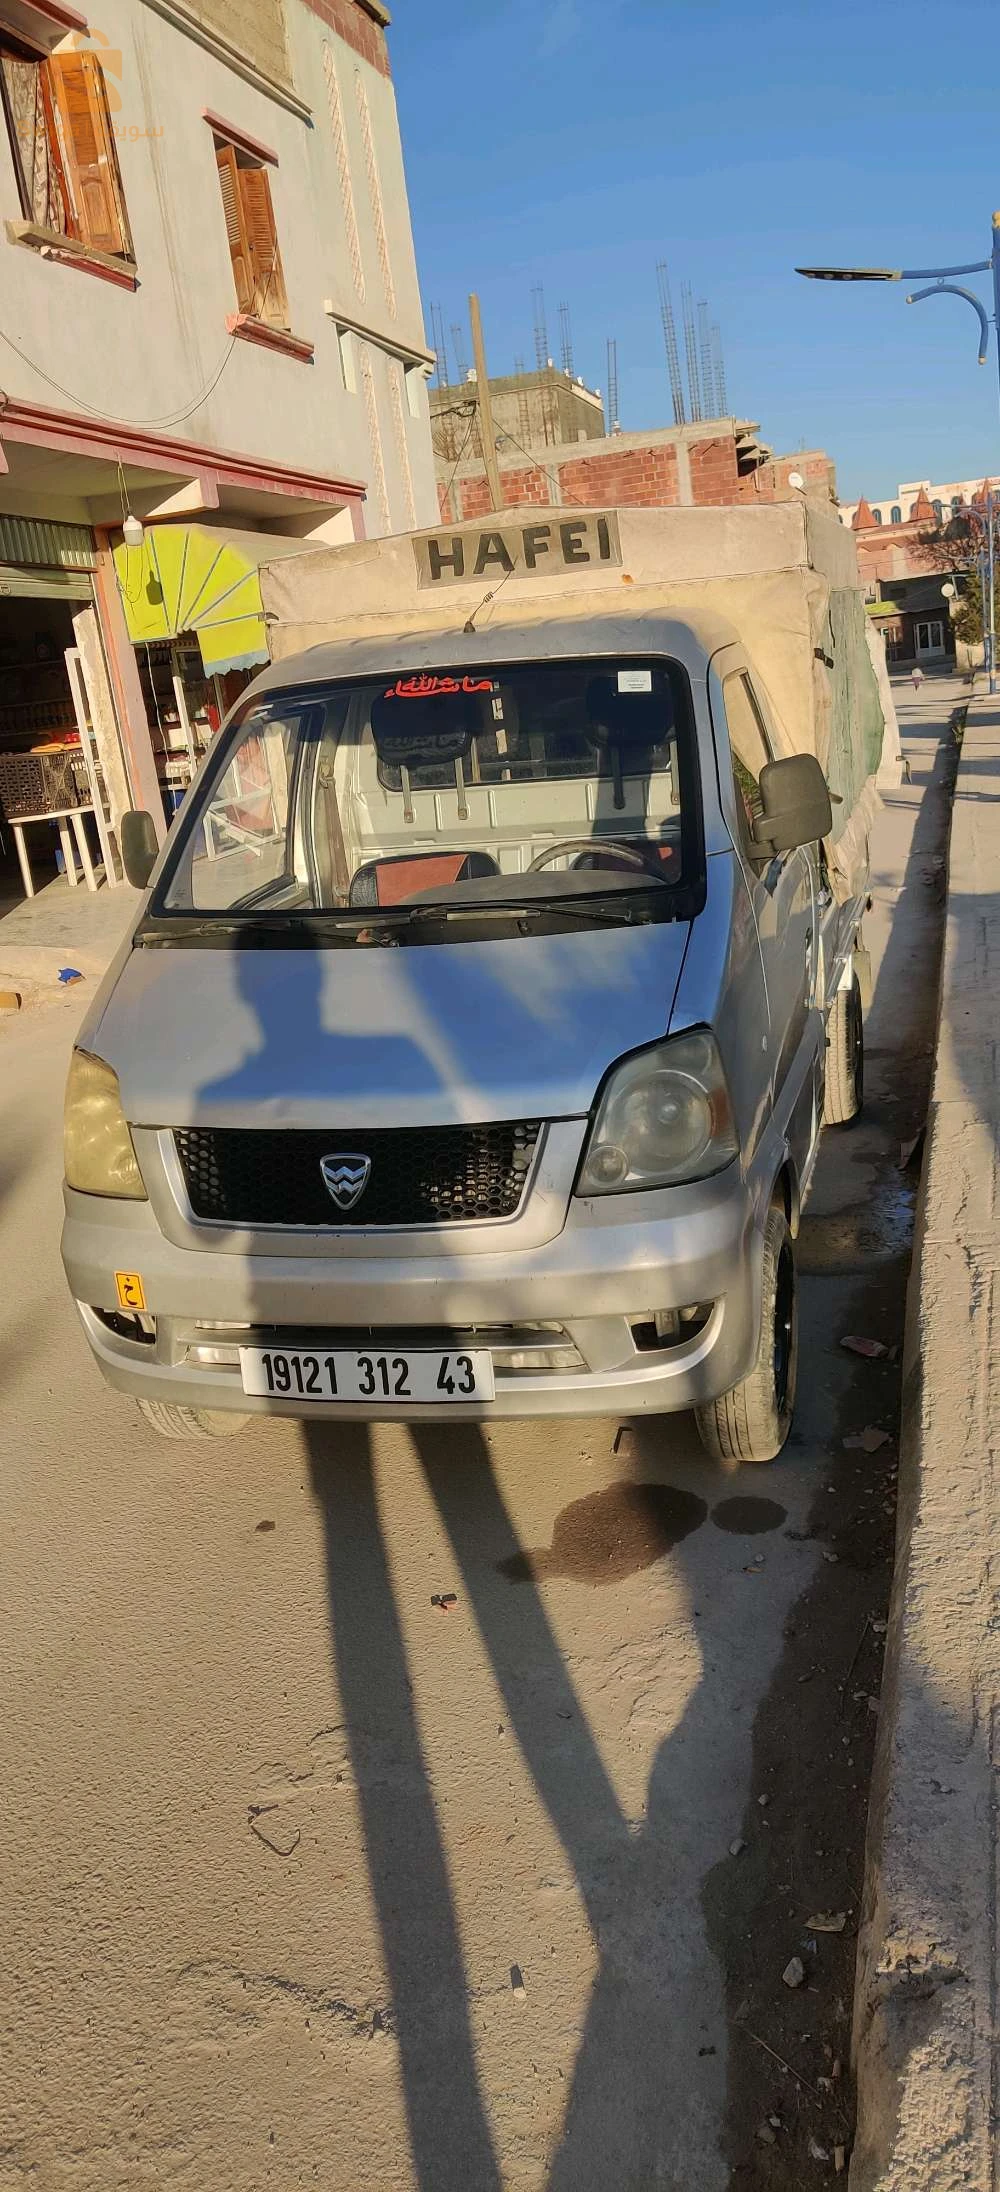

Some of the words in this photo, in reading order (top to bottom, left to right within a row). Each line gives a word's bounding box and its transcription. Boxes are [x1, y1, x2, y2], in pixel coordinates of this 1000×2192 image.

[427, 518, 611, 580] HAFEI
[261, 1353, 338, 1394] 19121
[358, 1356, 411, 1396] 312
[437, 1356, 476, 1394] 43
